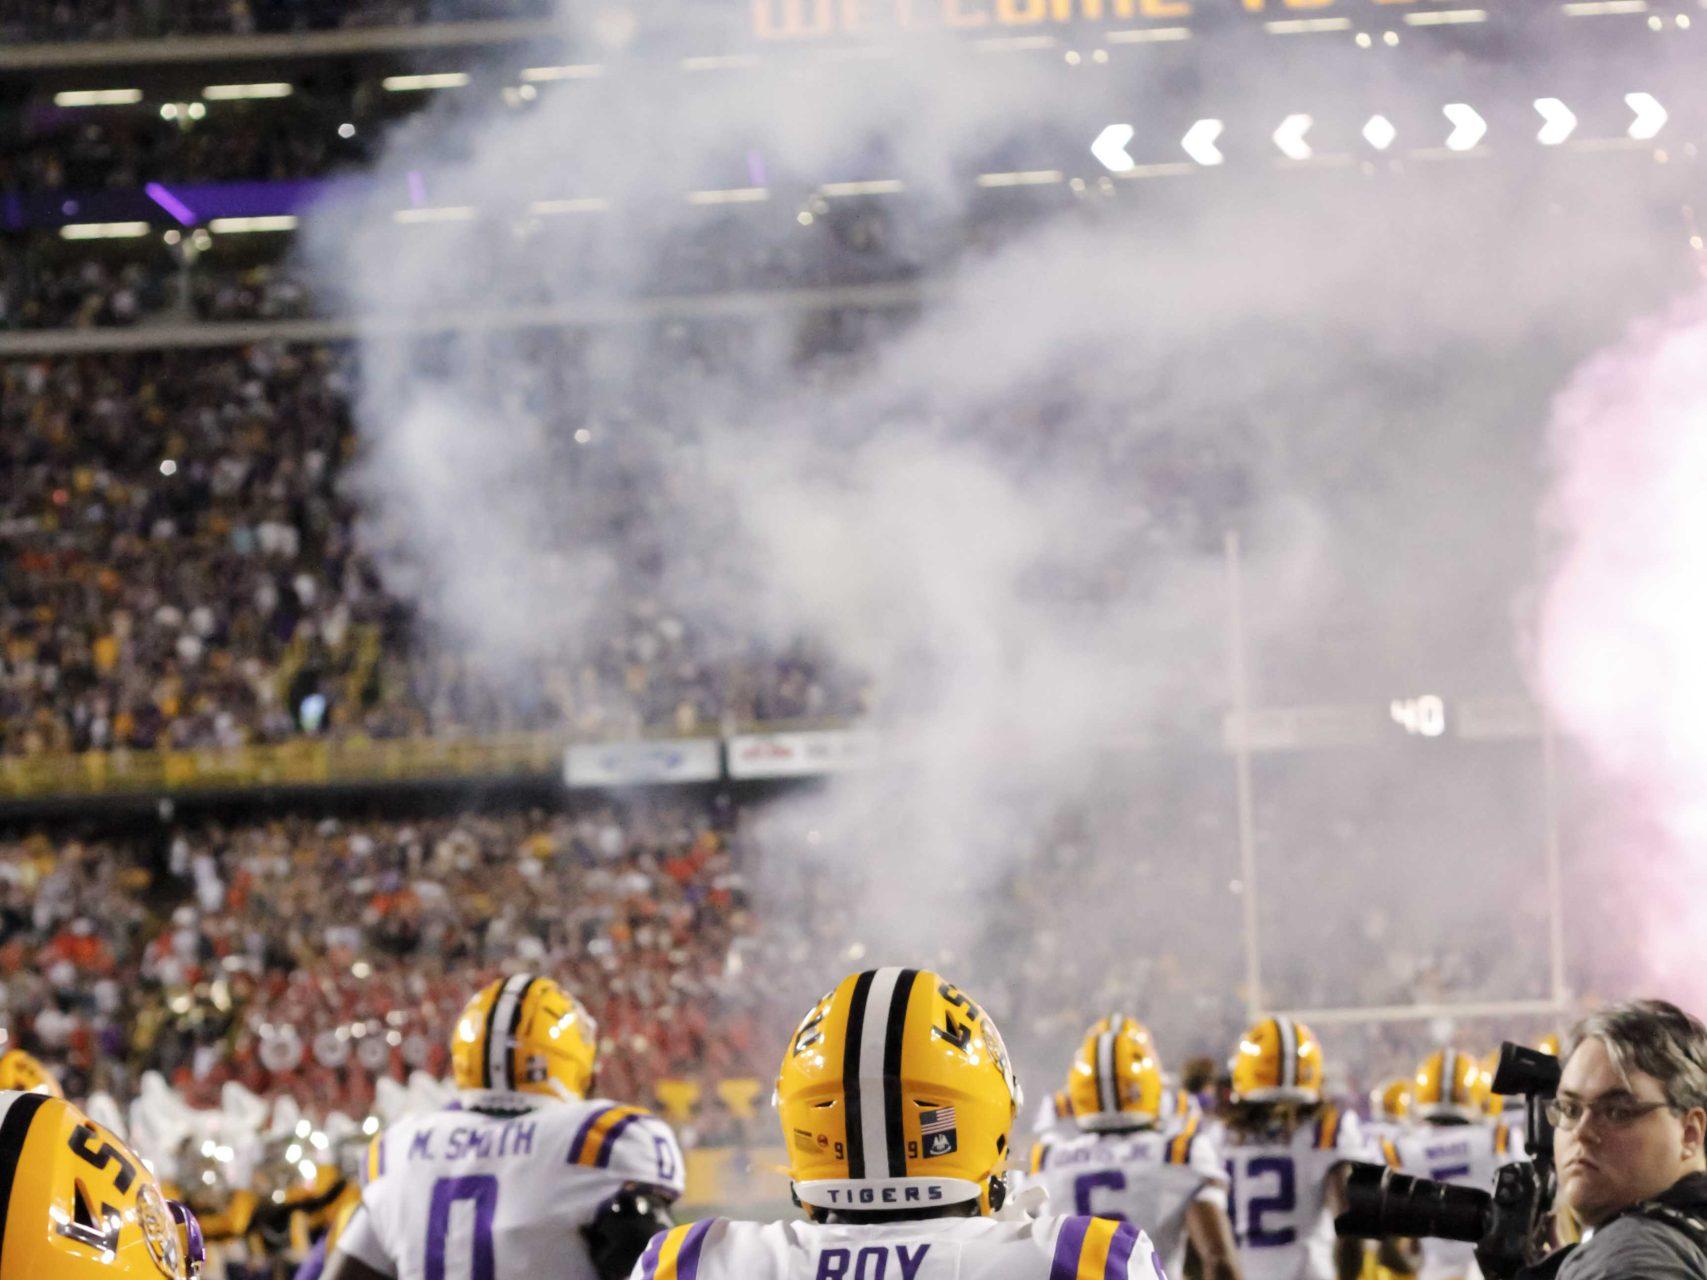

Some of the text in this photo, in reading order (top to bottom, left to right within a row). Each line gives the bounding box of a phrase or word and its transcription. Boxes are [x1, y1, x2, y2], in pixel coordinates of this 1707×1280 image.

[1390, 694, 1444, 737] 40
[445, 1122, 537, 1161] SMITH
[834, 1141, 918, 1160] 9 9
[827, 1185, 943, 1205] TIGERS
[1224, 1156, 1297, 1247] 12
